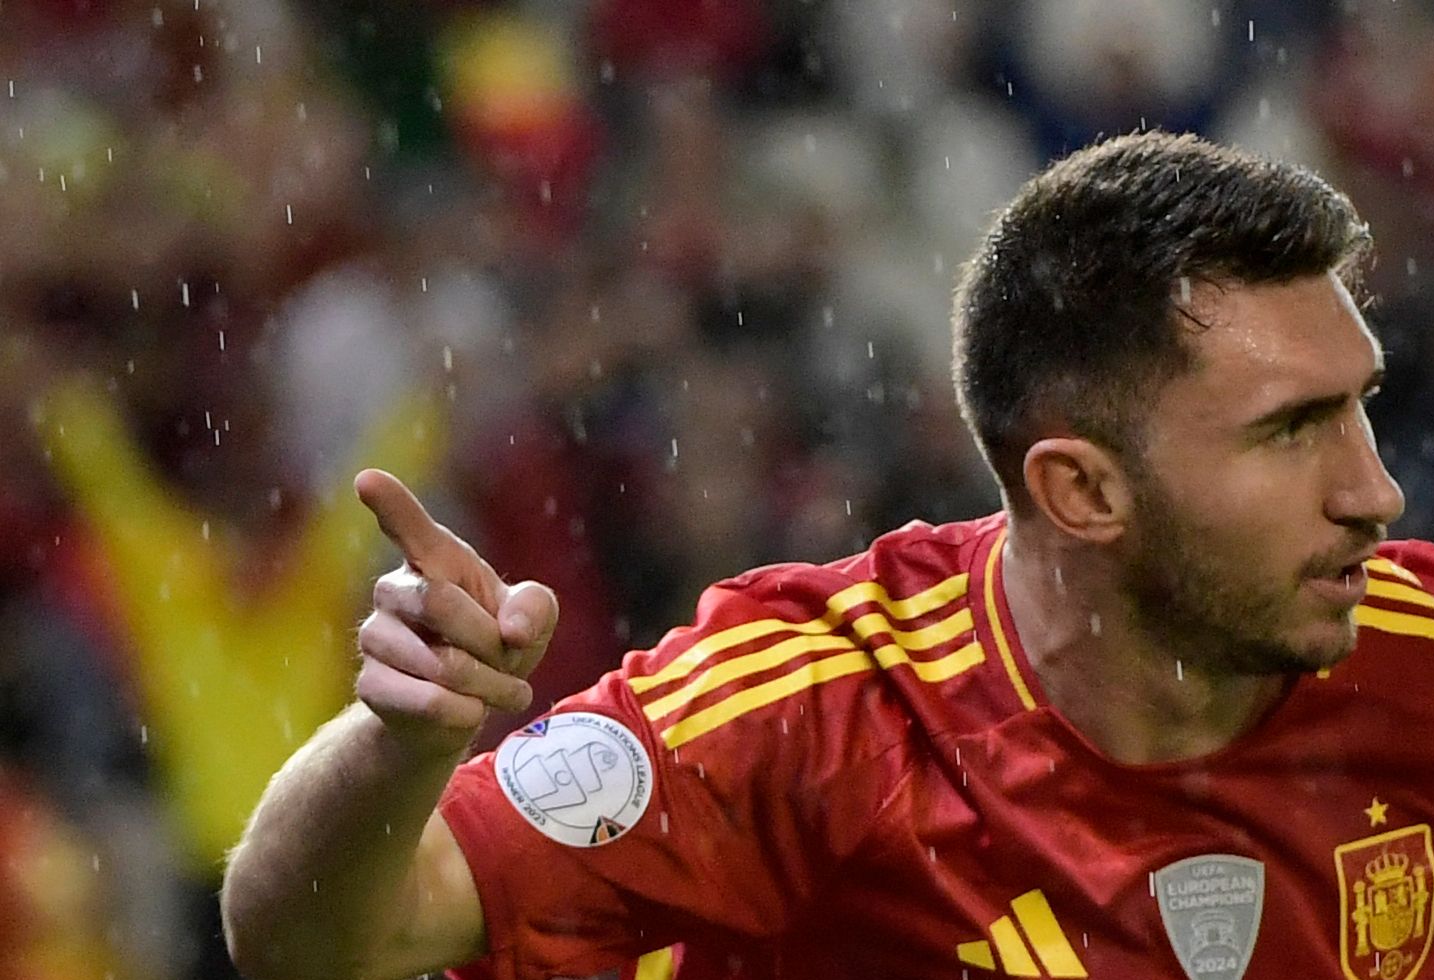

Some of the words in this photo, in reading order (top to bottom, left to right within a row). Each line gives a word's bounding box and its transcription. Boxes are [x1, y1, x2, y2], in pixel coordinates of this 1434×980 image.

[572, 716, 601, 726] UEFA
[604, 723, 641, 762] NATIONS
[632, 764, 646, 808] LEAGUE
[502, 767, 525, 803] WINNER
[1191, 863, 1225, 878] UEFA
[1167, 876, 1256, 896] EUROPEAN
[1168, 892, 1256, 911] CHAMPIONS
[1195, 956, 1237, 974] 2024
